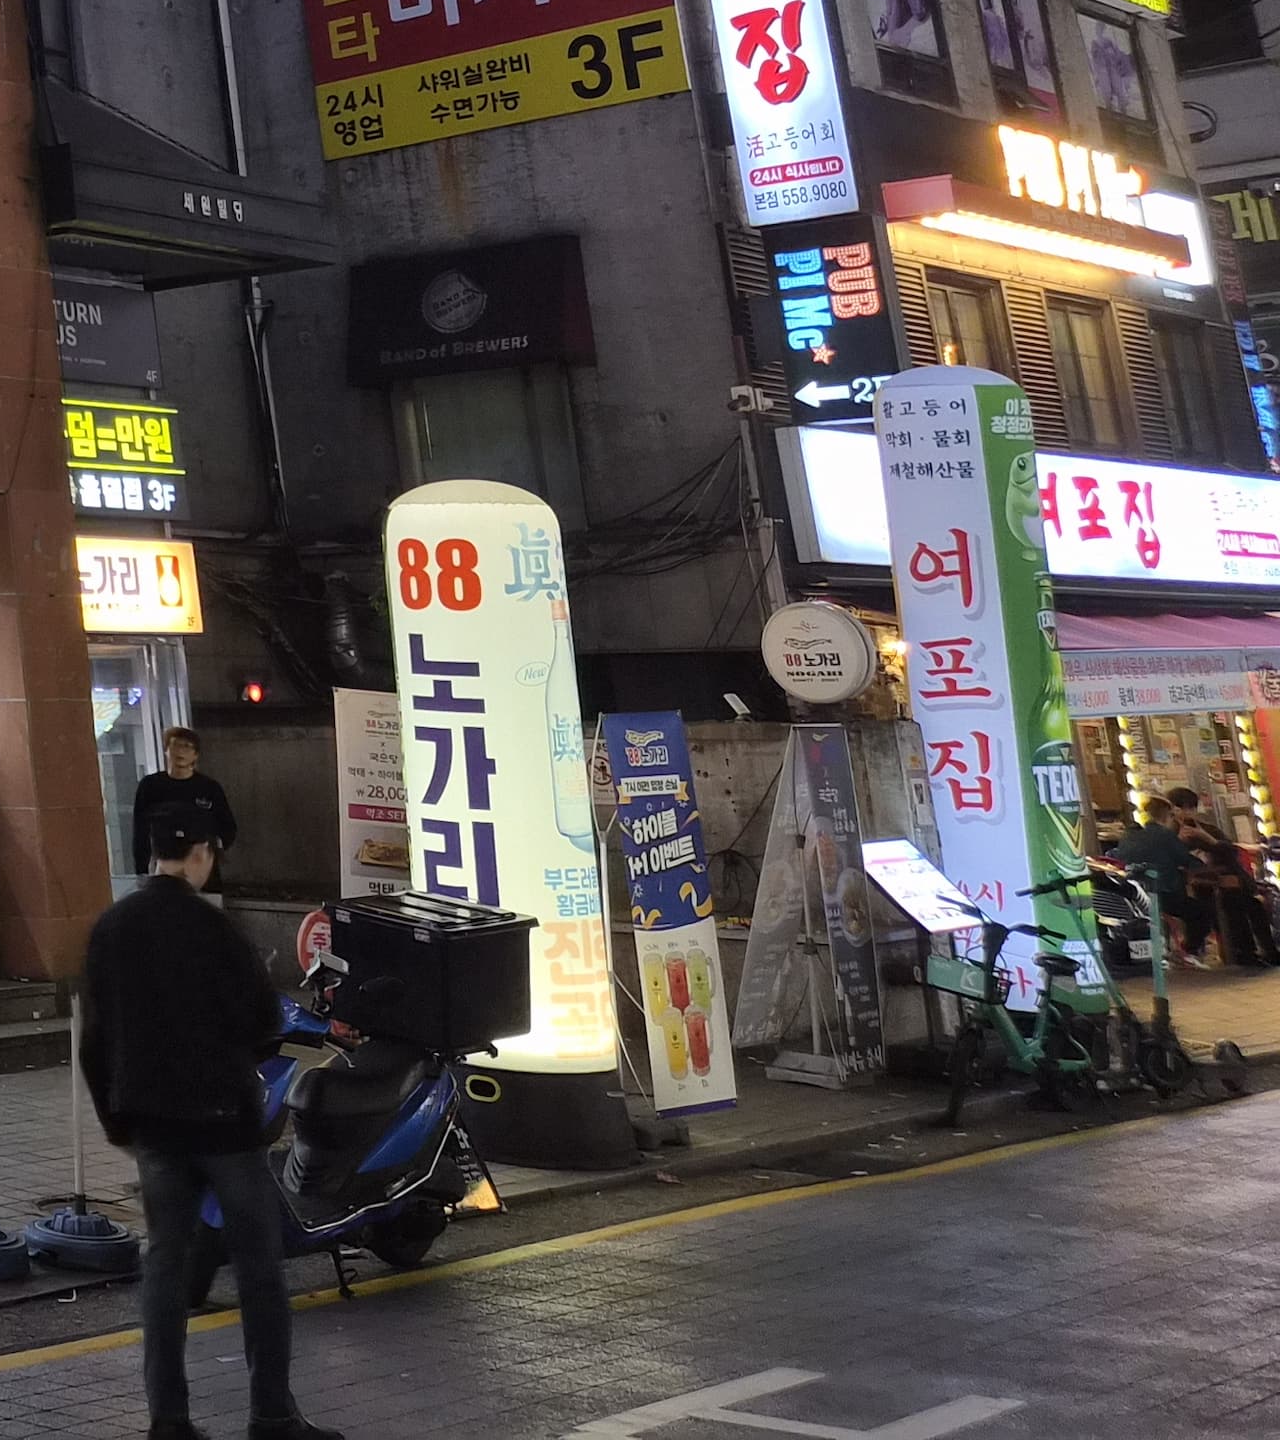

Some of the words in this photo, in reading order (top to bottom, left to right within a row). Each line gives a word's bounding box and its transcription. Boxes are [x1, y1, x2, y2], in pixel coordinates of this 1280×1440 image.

[567, 21, 664, 98] 3F
[327, 84, 384, 116] 24시
[417, 53, 531, 93] 샤워실완비
[335, 114, 384, 146] 영업
[430, 89, 521, 124] 수면가능
[753, 167, 783, 185] 24시
[754, 190, 778, 211] 본점
[781, 182, 847, 209] 558.9080
[823, 242, 880, 319] PUB
[146, 369, 158, 383] 4F
[886, 430, 912, 448] 막회
[932, 429, 971, 448] 물회
[889, 459, 975, 480] 제철해산물
[79, 474, 144, 511] 홀덤펍
[148, 478, 177, 512] 3F
[397, 539, 482, 611] 88
[524, 665, 547, 681] New
[804, 653, 841, 666] 노가리
[910, 529, 994, 814] 여포집
[377, 720, 400, 730] 노가리
[409, 633, 497, 906] 노가리
[367, 784, 408, 803] 28,00
[632, 808, 677, 845] 하이볼
[650, 835, 696, 873] 이벤트
[369, 882, 395, 896] 먹태
